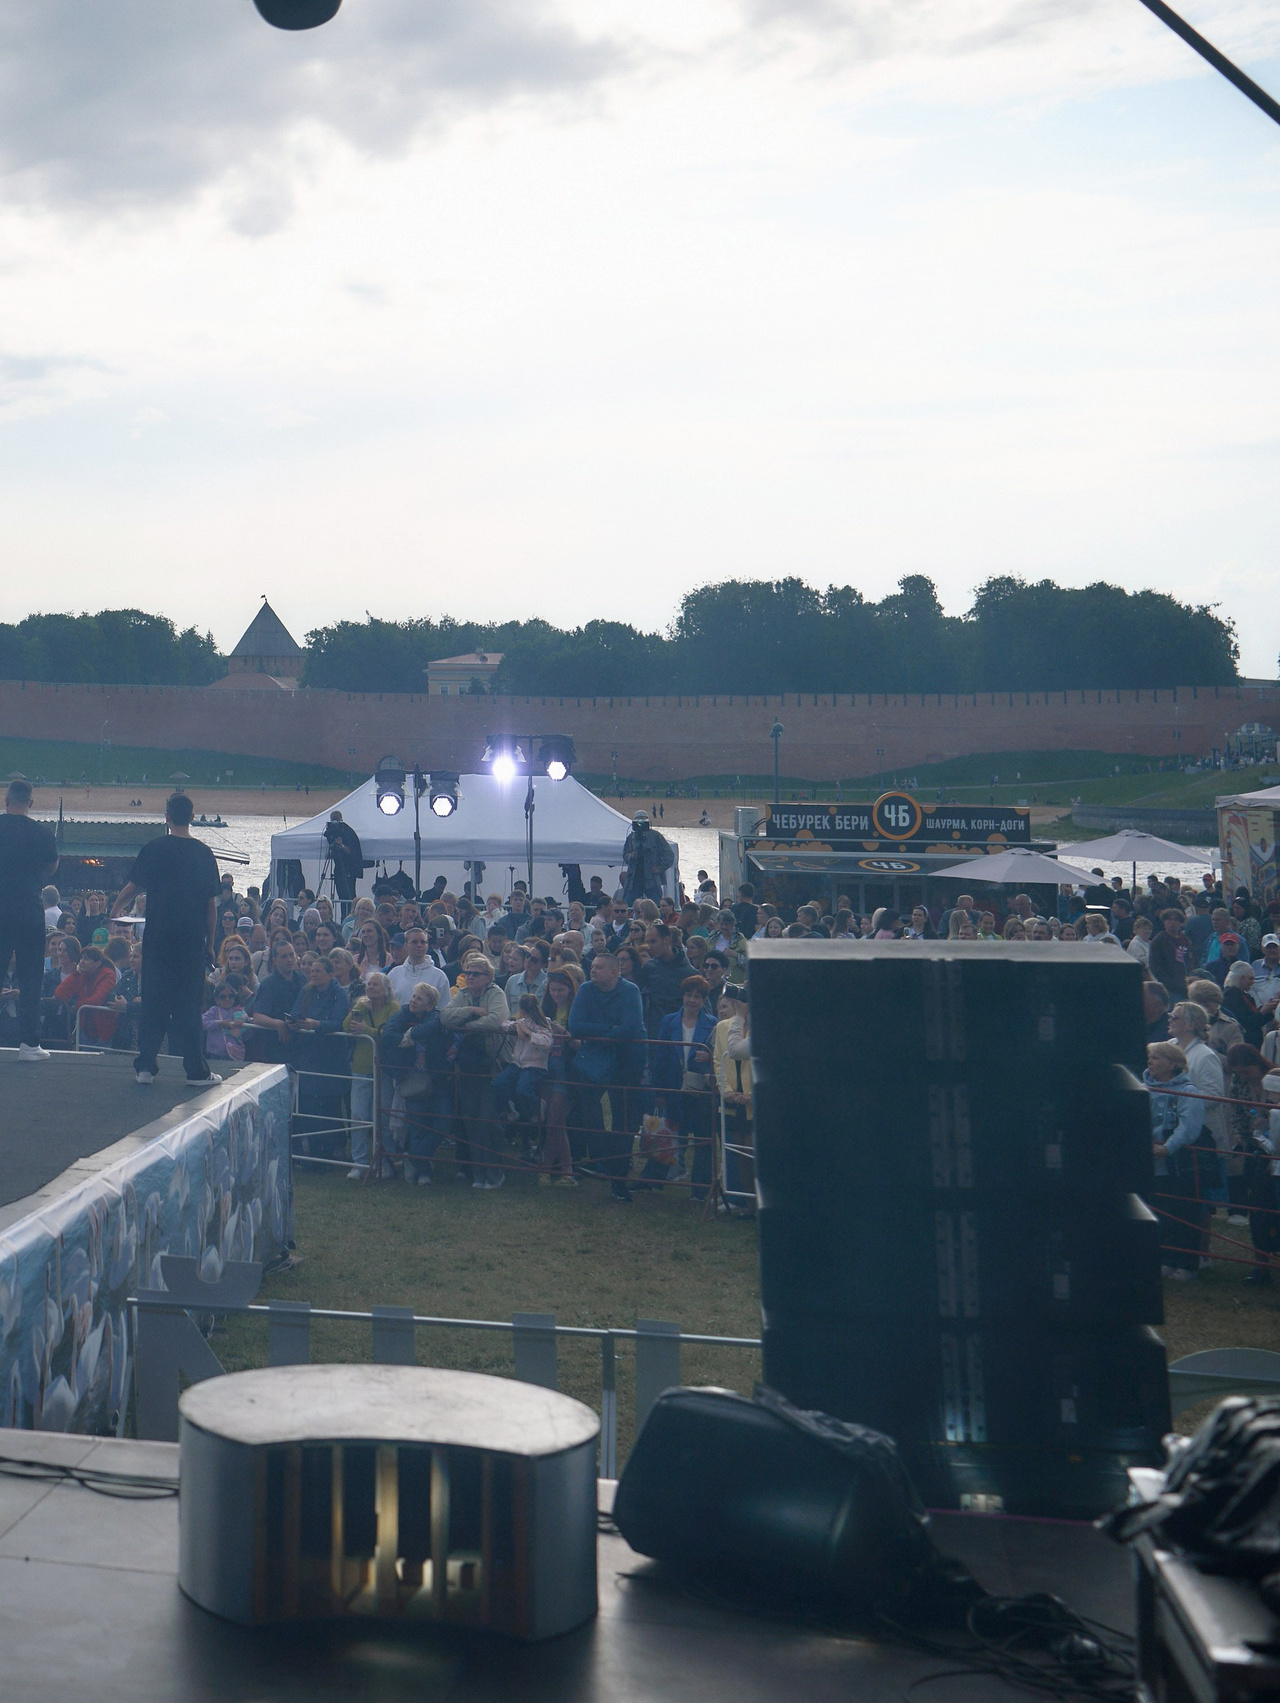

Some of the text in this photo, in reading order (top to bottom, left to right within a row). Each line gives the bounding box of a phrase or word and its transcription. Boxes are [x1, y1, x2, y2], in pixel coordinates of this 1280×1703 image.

[772, 813, 869, 831] ЧЕБУРЕК БЕРИ
[884, 804, 910, 827] ЧБ
[926, 818, 1025, 832] ШАУРМА, КОРН-ДОГИ
[871, 861, 907, 870] ЧБ
